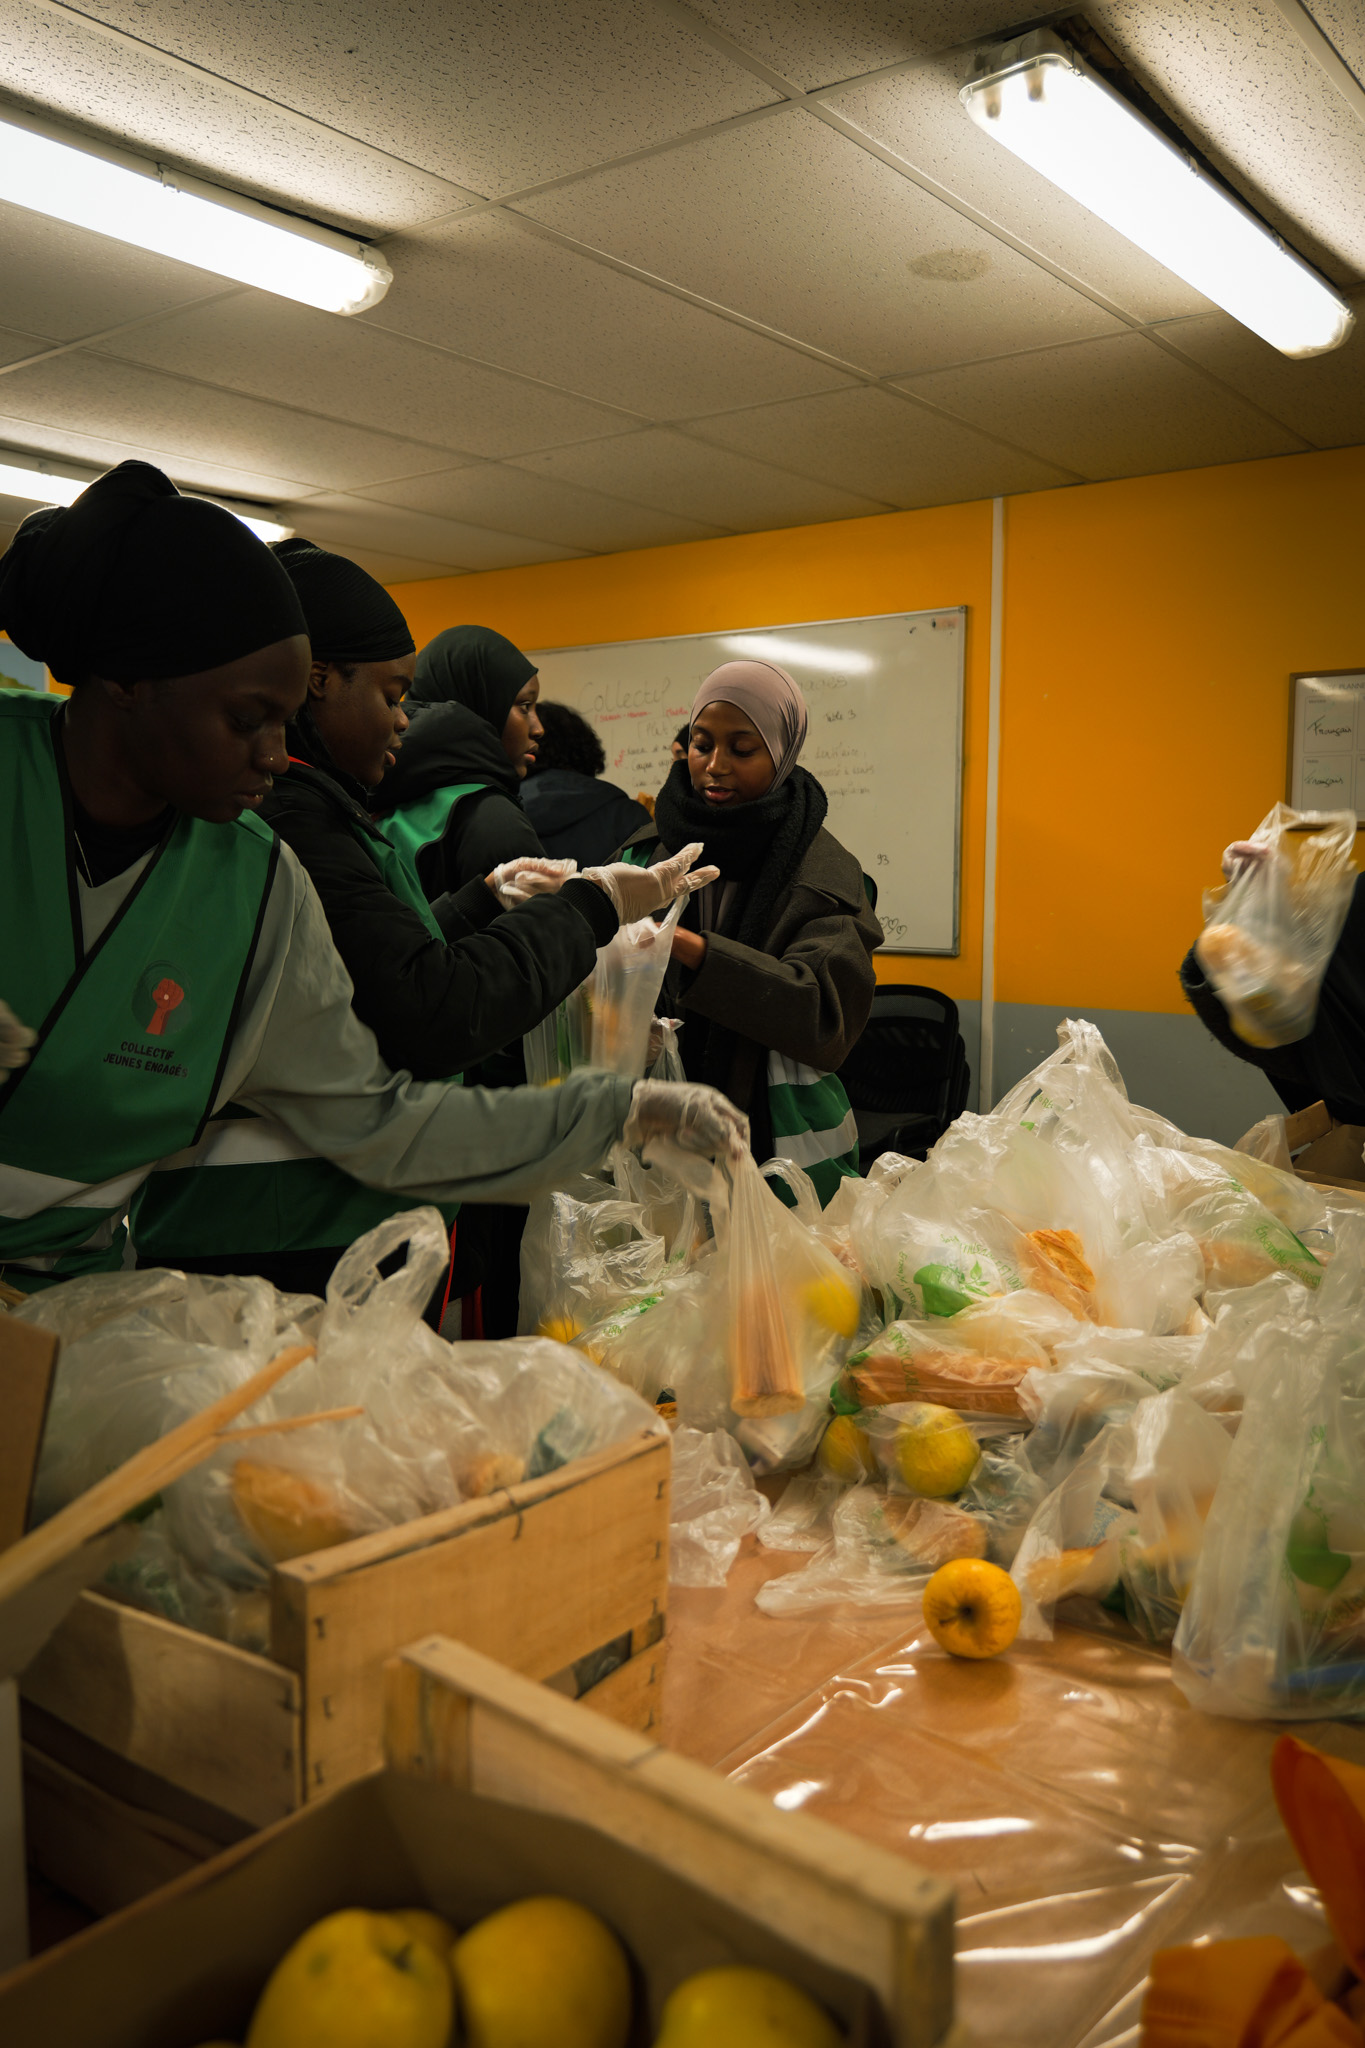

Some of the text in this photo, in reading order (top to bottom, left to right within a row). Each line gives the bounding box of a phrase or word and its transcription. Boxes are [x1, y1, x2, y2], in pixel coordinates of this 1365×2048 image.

[577, 676, 671, 715] Collectif
[120, 1040, 175, 1060] COLLECTIF
[103, 1052, 188, 1078] JEUNES ENGAGÉS
